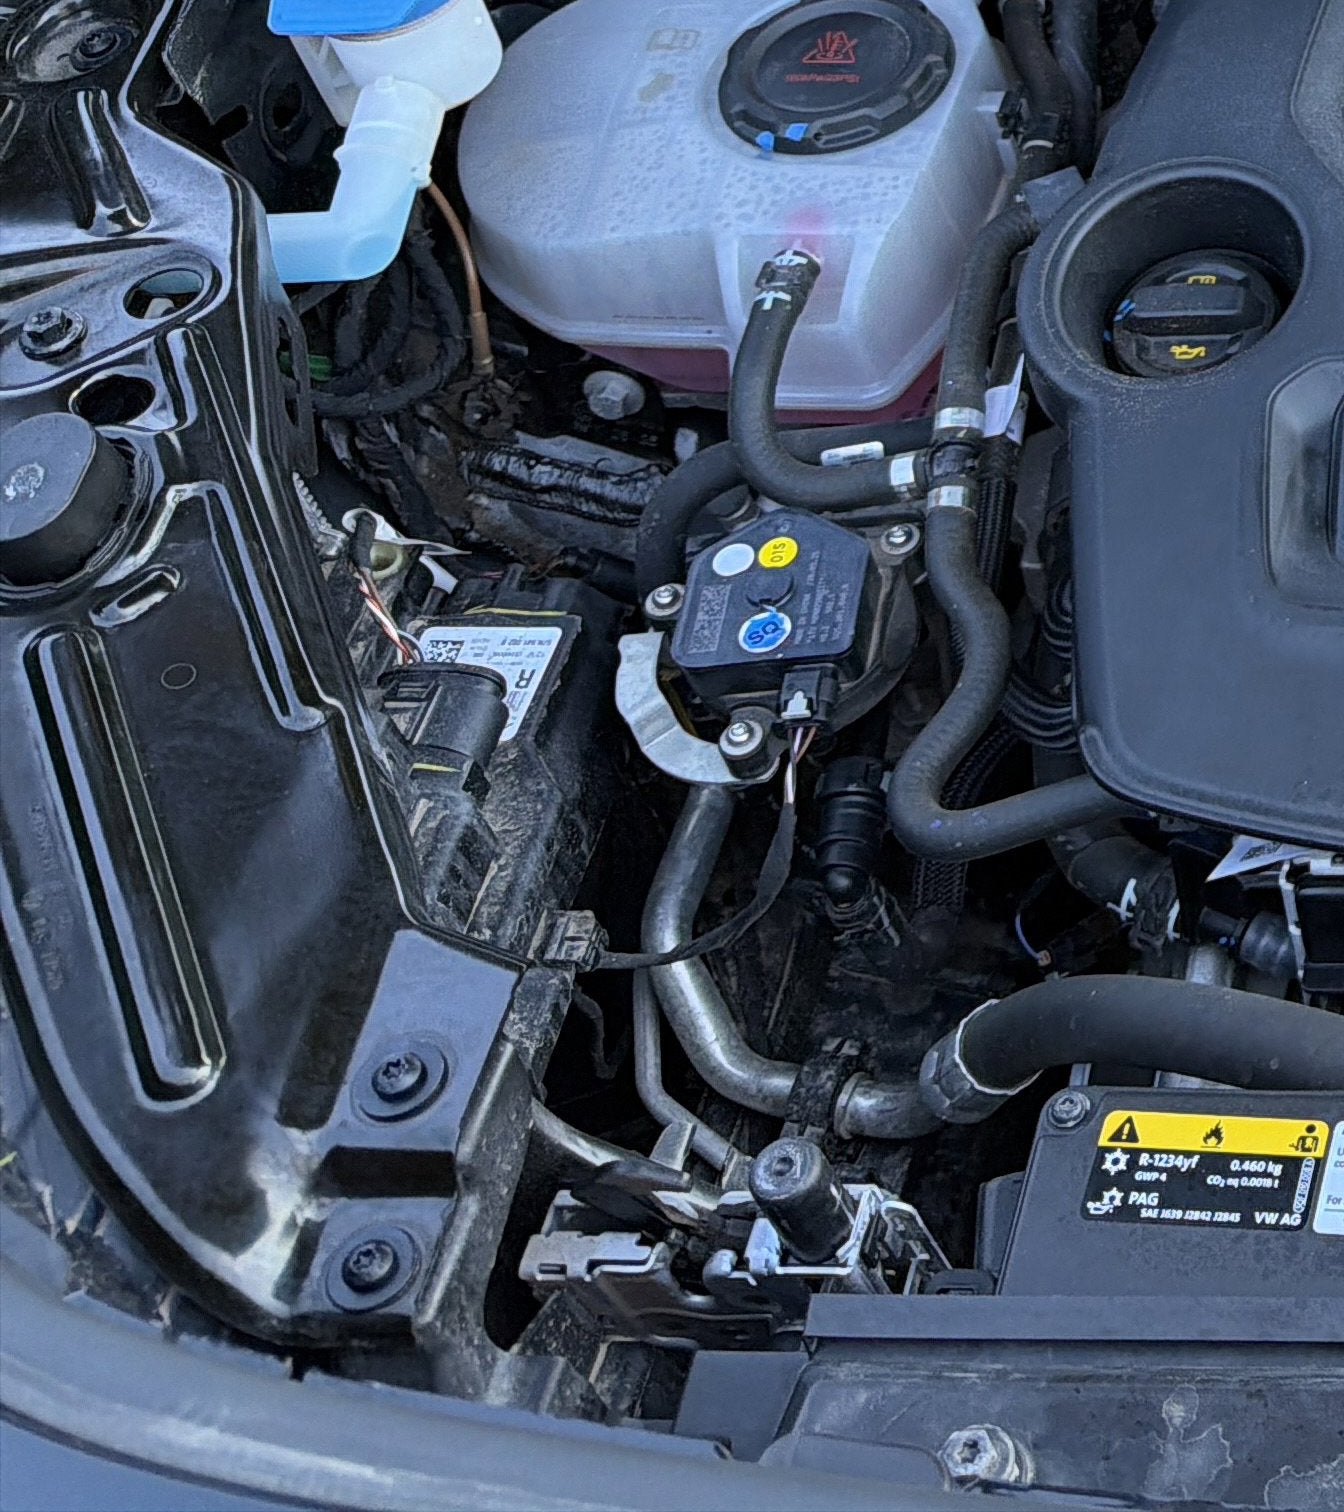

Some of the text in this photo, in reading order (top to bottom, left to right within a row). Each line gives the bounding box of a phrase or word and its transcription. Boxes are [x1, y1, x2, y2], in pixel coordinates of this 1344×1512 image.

[770, 542, 786, 563] 015
[748, 621, 779, 645] SQ
[515, 669, 537, 689] R
[1139, 1153, 1200, 1172] R-1234yf
[1230, 1159, 1283, 1177] 0.460 kg
[1134, 1171, 1167, 1182] GWP 4
[1226, 1177, 1239, 1188] eq
[1128, 1191, 1159, 1206] PAG
[1326, 1194, 1342, 1205] For
[1139, 1208, 1242, 1222] SAE J639 J2842 J2845
[1254, 1211, 1302, 1226] VW AG
